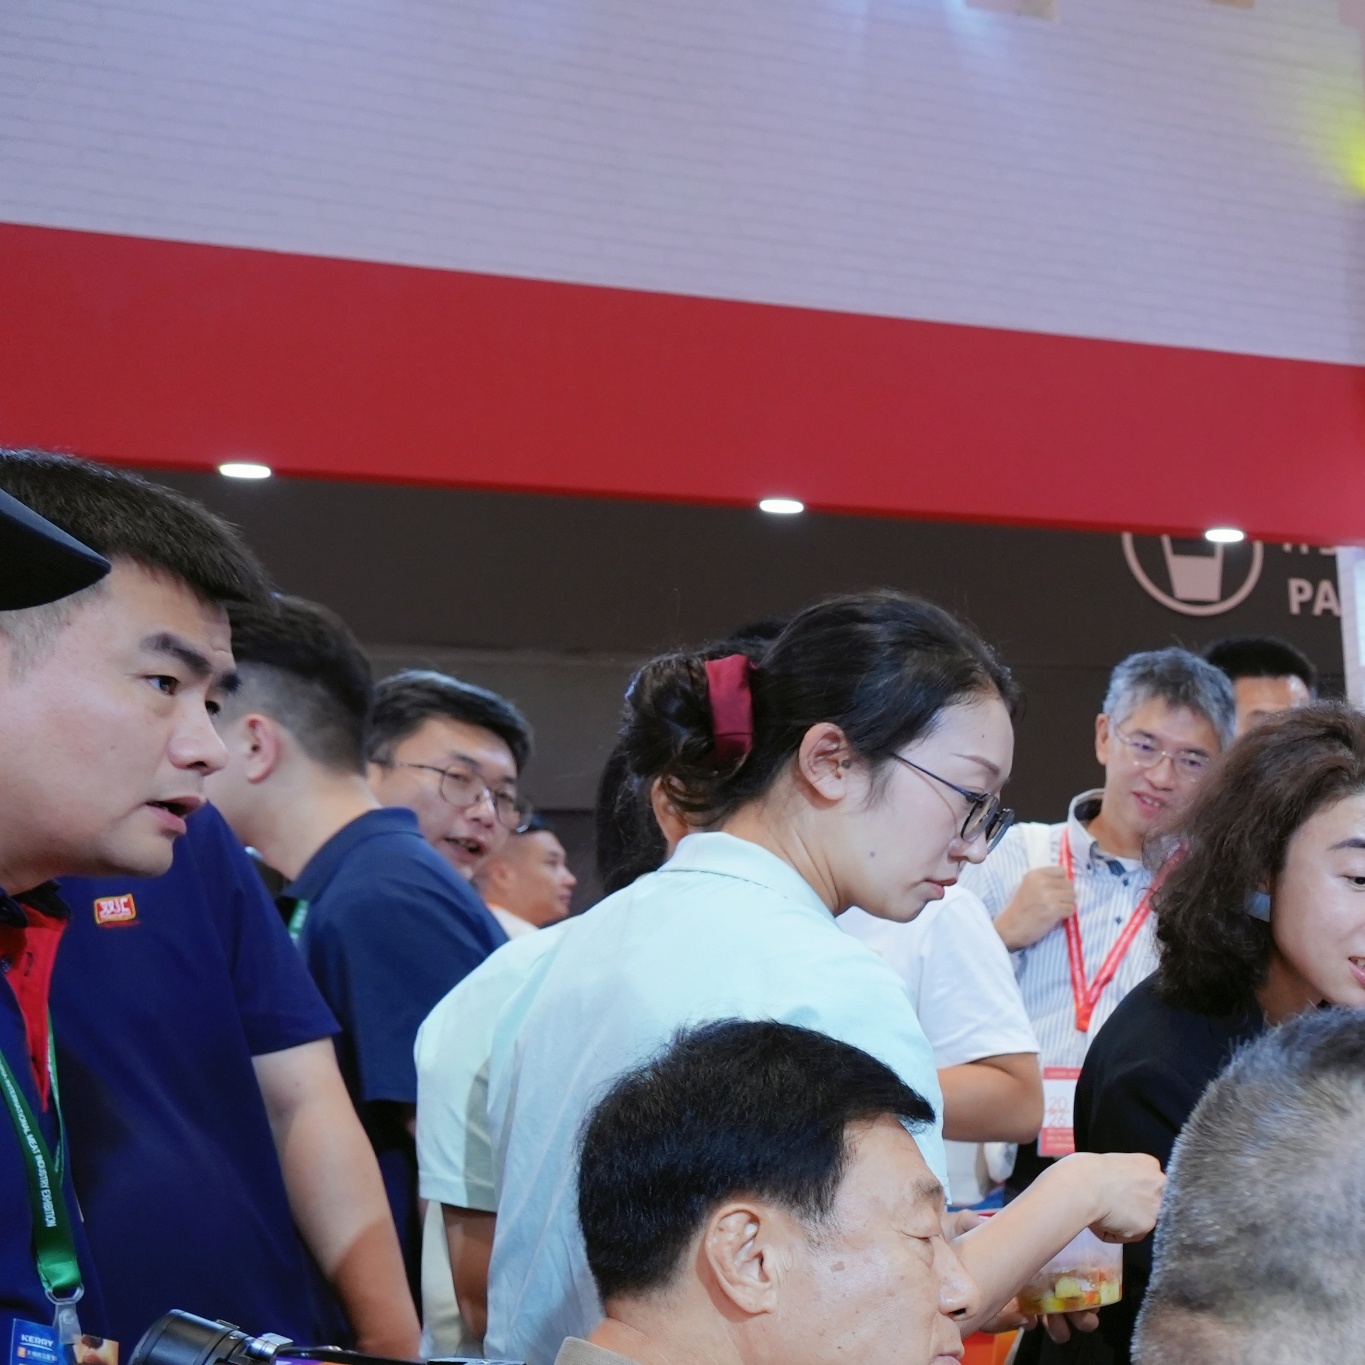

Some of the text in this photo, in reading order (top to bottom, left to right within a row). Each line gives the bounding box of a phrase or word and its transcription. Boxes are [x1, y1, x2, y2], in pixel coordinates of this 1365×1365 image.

[25, 1133, 40, 1154] MEAT
[34, 1153, 49, 1189] INDUSTRY
[21, 1334, 54, 1347] KERRY
